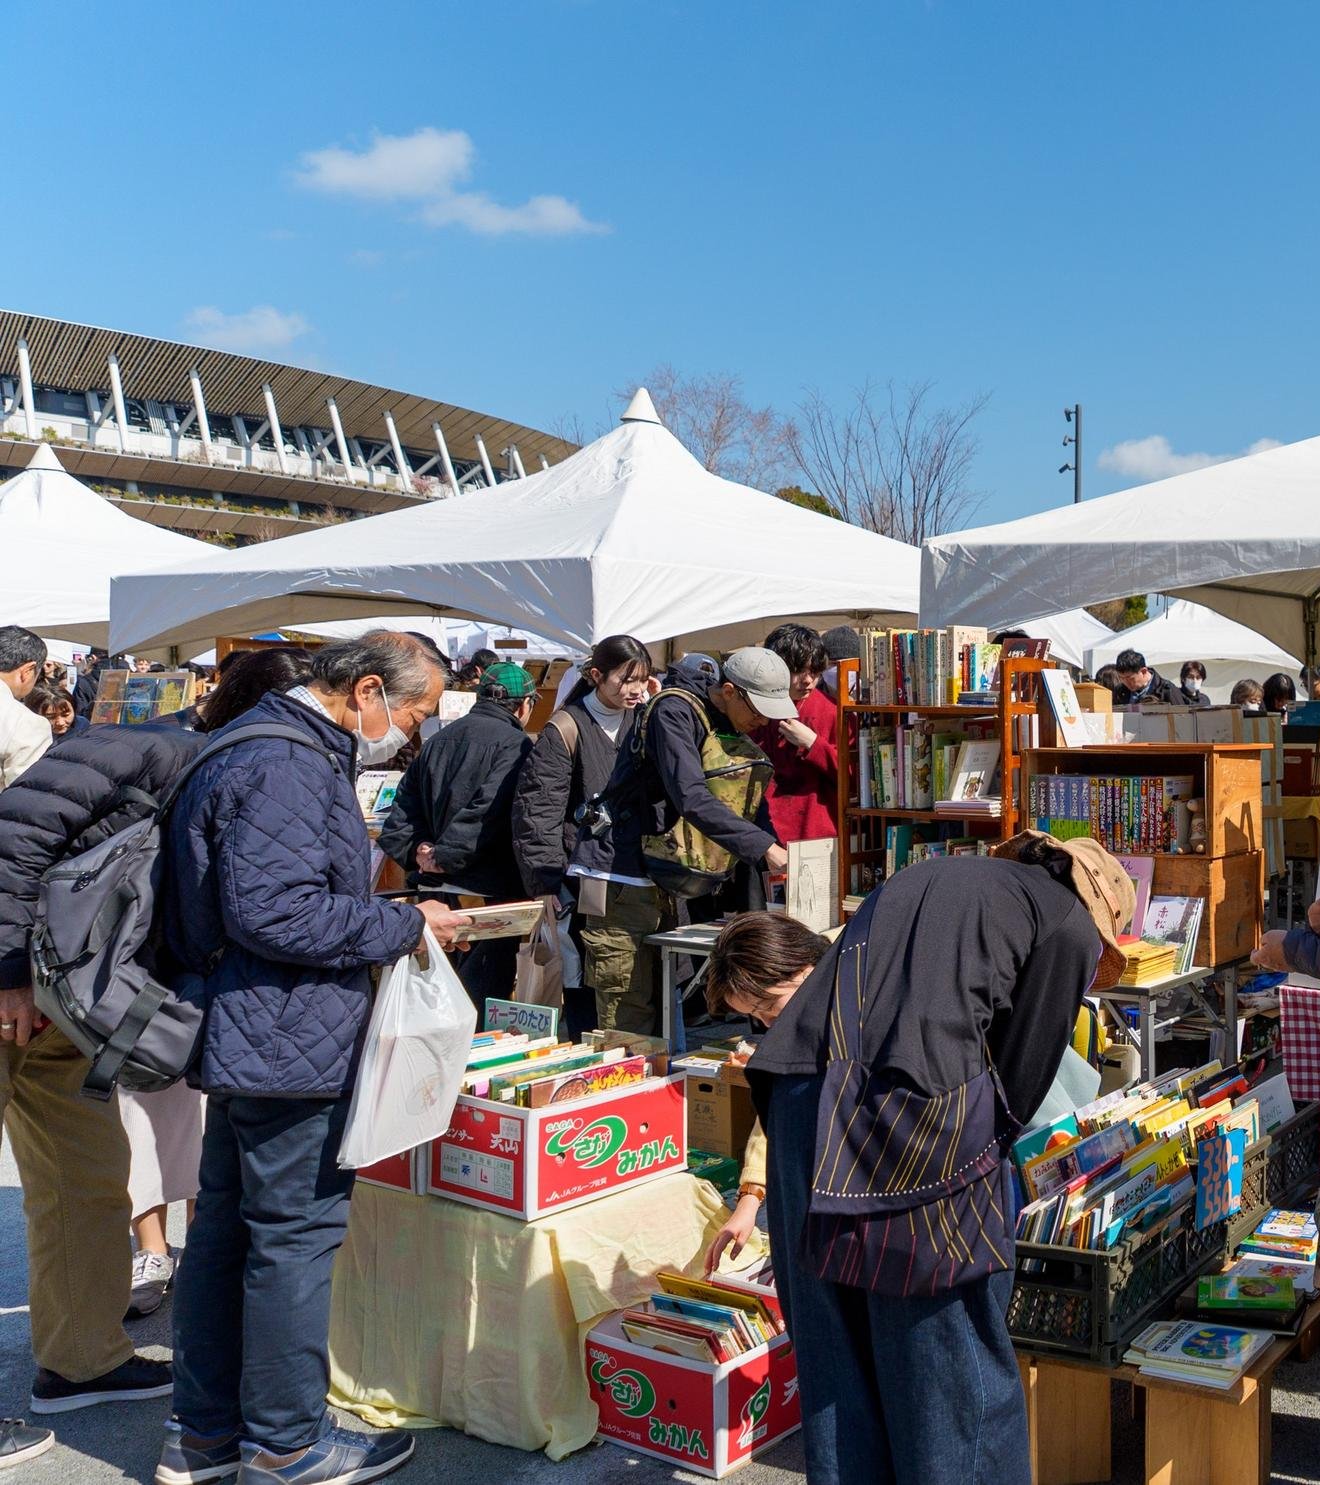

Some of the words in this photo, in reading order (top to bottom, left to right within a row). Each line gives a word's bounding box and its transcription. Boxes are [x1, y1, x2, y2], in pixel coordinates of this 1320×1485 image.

[1154, 905, 1169, 929] 赤松
[545, 1119, 574, 1133] SAGA
[489, 1132, 519, 1155] 天山
[616, 1135, 679, 1176] みかん
[649, 1416, 708, 1459] みかん
